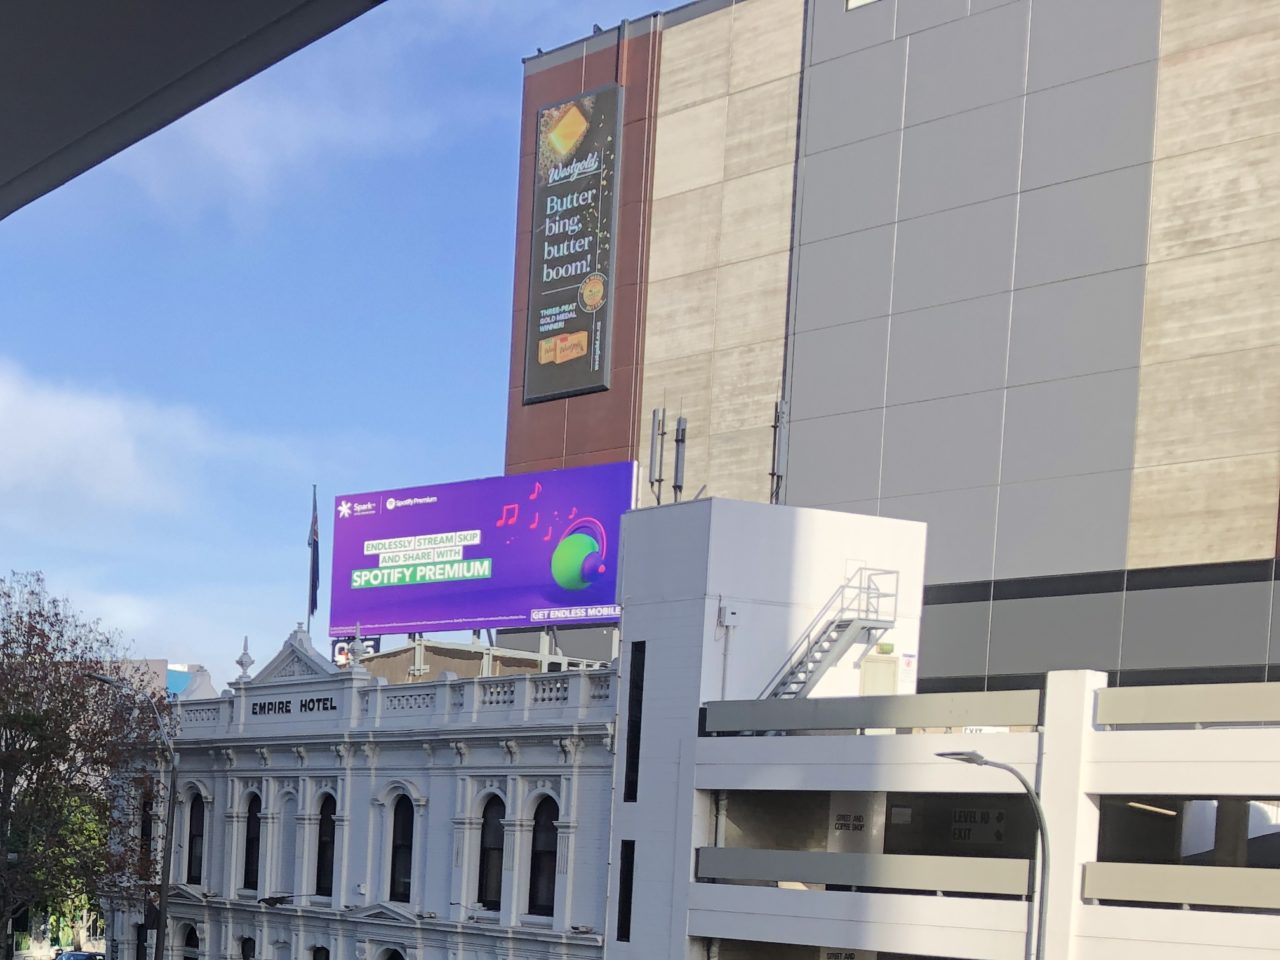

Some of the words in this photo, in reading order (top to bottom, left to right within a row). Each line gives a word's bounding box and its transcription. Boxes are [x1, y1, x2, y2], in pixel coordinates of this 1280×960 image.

[548, 151, 599, 183] Westgold
[546, 188, 597, 215] Butter
[545, 214, 583, 236] bing,
[543, 235, 593, 260] butter
[542, 254, 592, 282] boom!
[556, 311, 577, 321] MEDAL
[366, 539, 413, 552] ENDLESSLY
[416, 534, 454, 547] STREAM
[457, 532, 478, 543] SKIP
[381, 554, 401, 564] AND
[402, 551, 432, 562] SHARE
[436, 548, 461, 559] WITH
[352, 567, 413, 587] SPOTIFY
[416, 560, 489, 580] PREMIUM
[532, 610, 550, 619] GET
[550, 608, 586, 618] ENDLESS
[587, 606, 621, 616] MOBILE
[251, 700, 292, 715] EMPIRE
[300, 697, 337, 713] HOTEL
